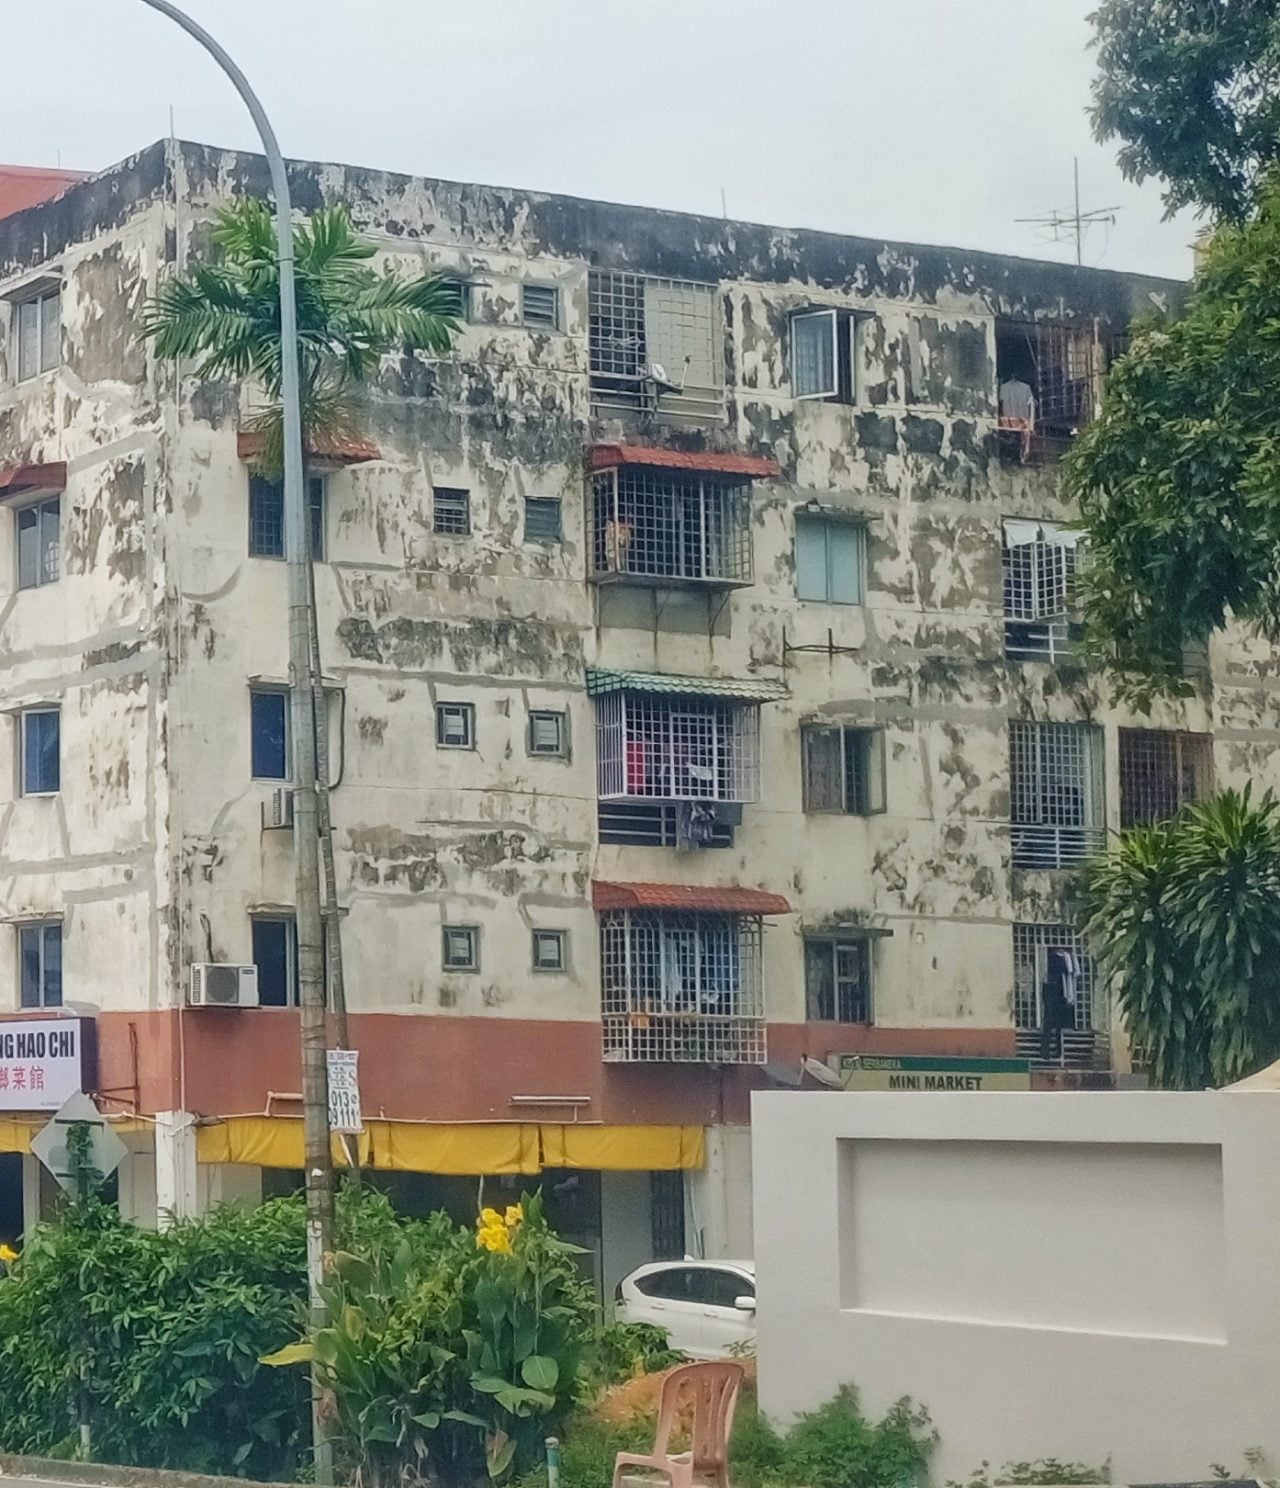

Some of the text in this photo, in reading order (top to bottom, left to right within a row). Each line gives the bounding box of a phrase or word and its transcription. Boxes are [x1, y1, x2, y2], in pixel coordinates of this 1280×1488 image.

[16, 1032, 46, 1059] HAO
[49, 1030, 74, 1058] CHI
[889, 1075, 983, 1091] MINI MARKET
